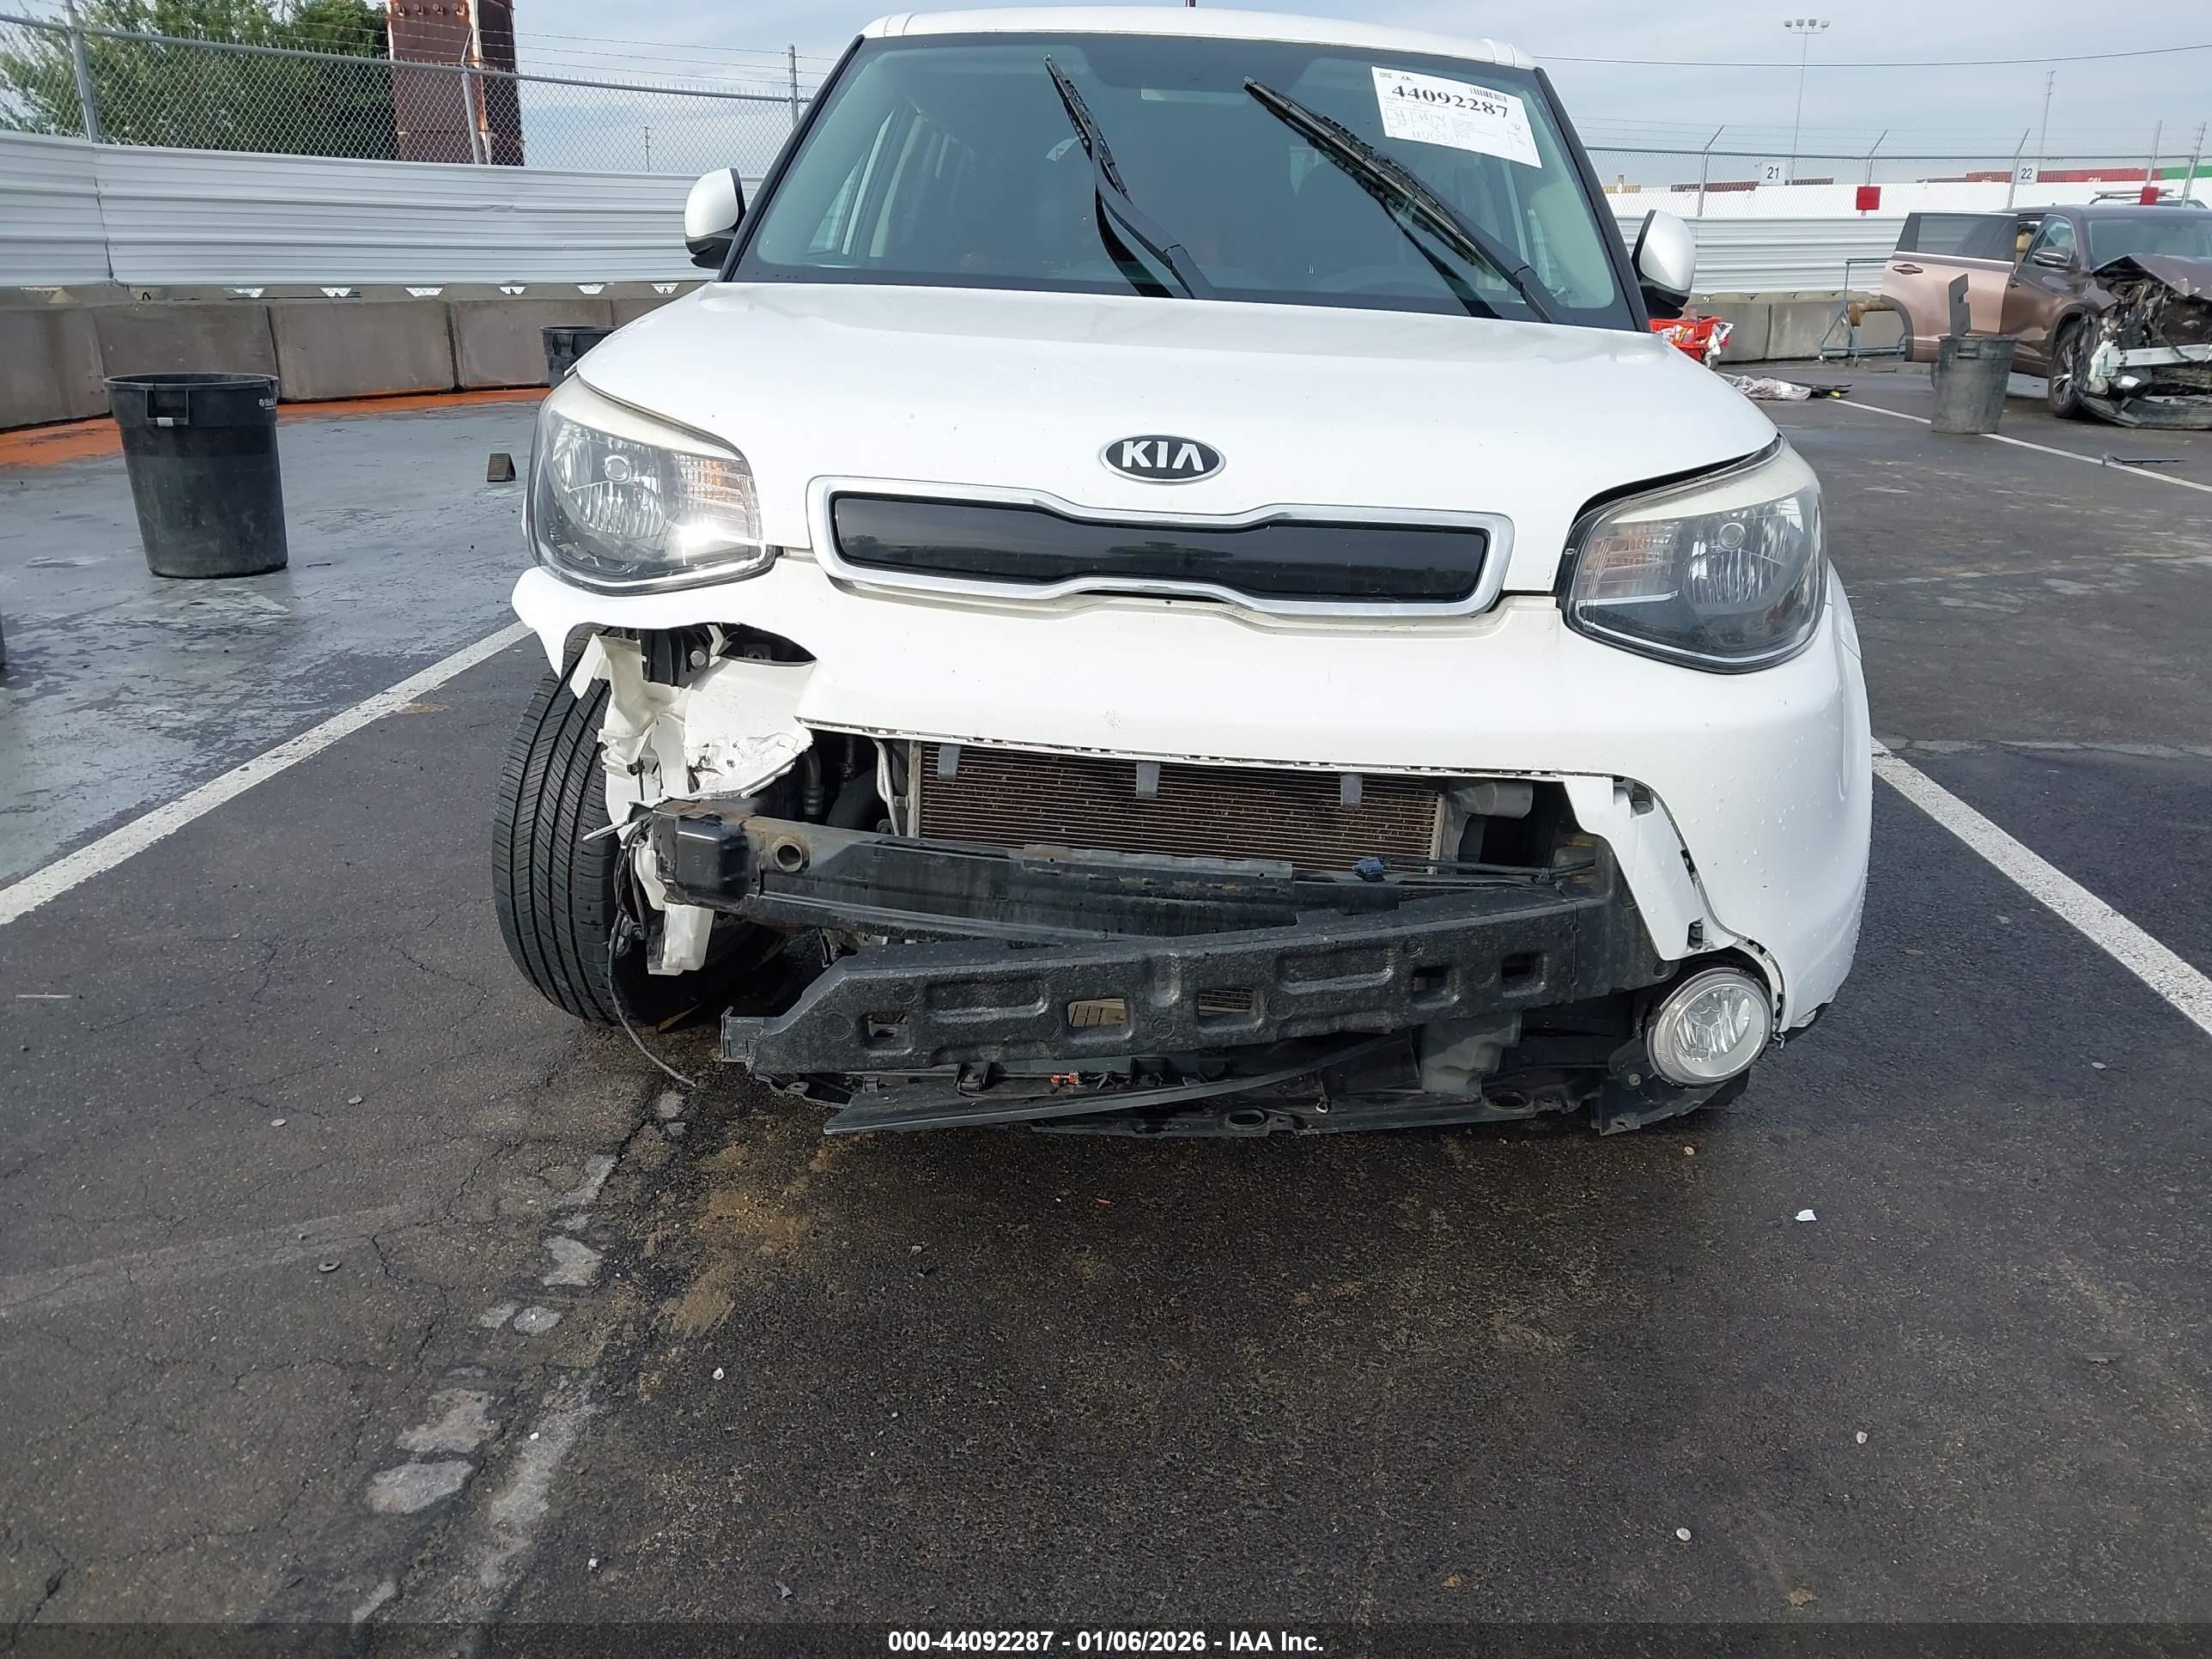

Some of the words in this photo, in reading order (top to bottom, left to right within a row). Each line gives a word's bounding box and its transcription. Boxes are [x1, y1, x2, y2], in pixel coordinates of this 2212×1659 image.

[1391, 85, 1509, 118] 44092287
[1766, 166, 1780, 179] 21
[2021, 167, 2033, 179] 22
[1121, 441, 1205, 471] KIA
